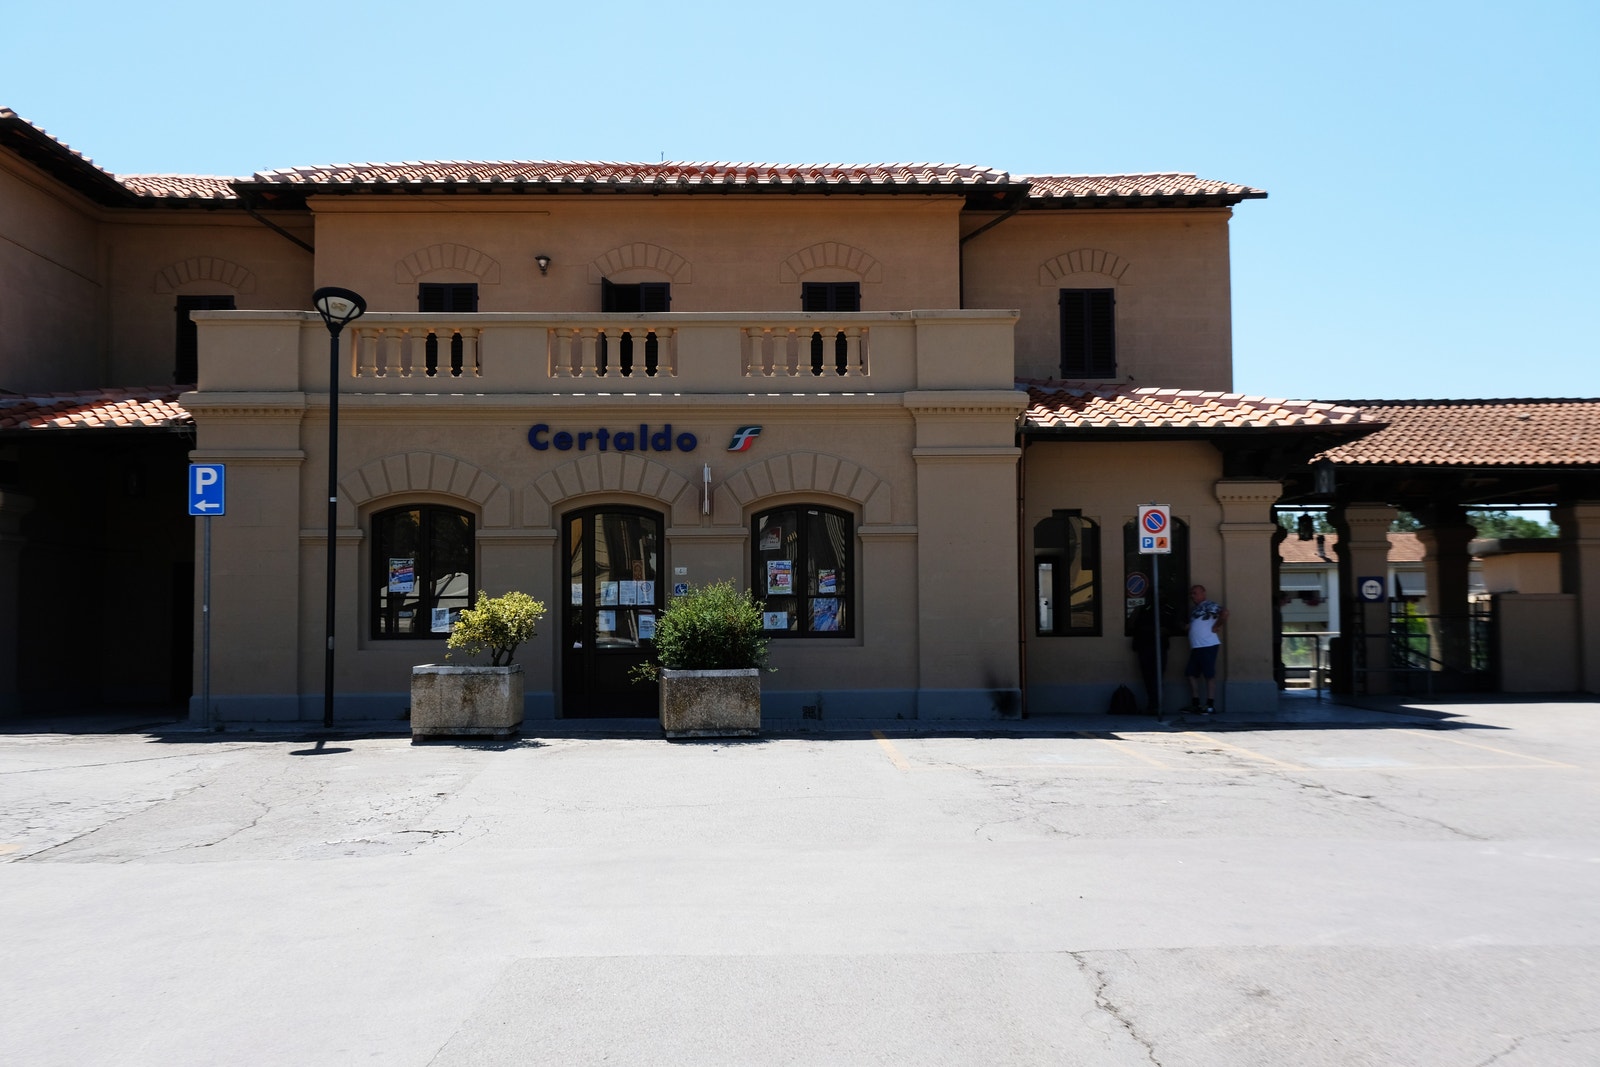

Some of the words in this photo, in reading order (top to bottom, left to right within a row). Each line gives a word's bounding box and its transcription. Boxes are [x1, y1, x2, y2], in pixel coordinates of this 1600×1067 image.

[528, 424, 698, 452] Certaldo
[196, 468, 217, 494] P
[1144, 538, 1152, 547] P
